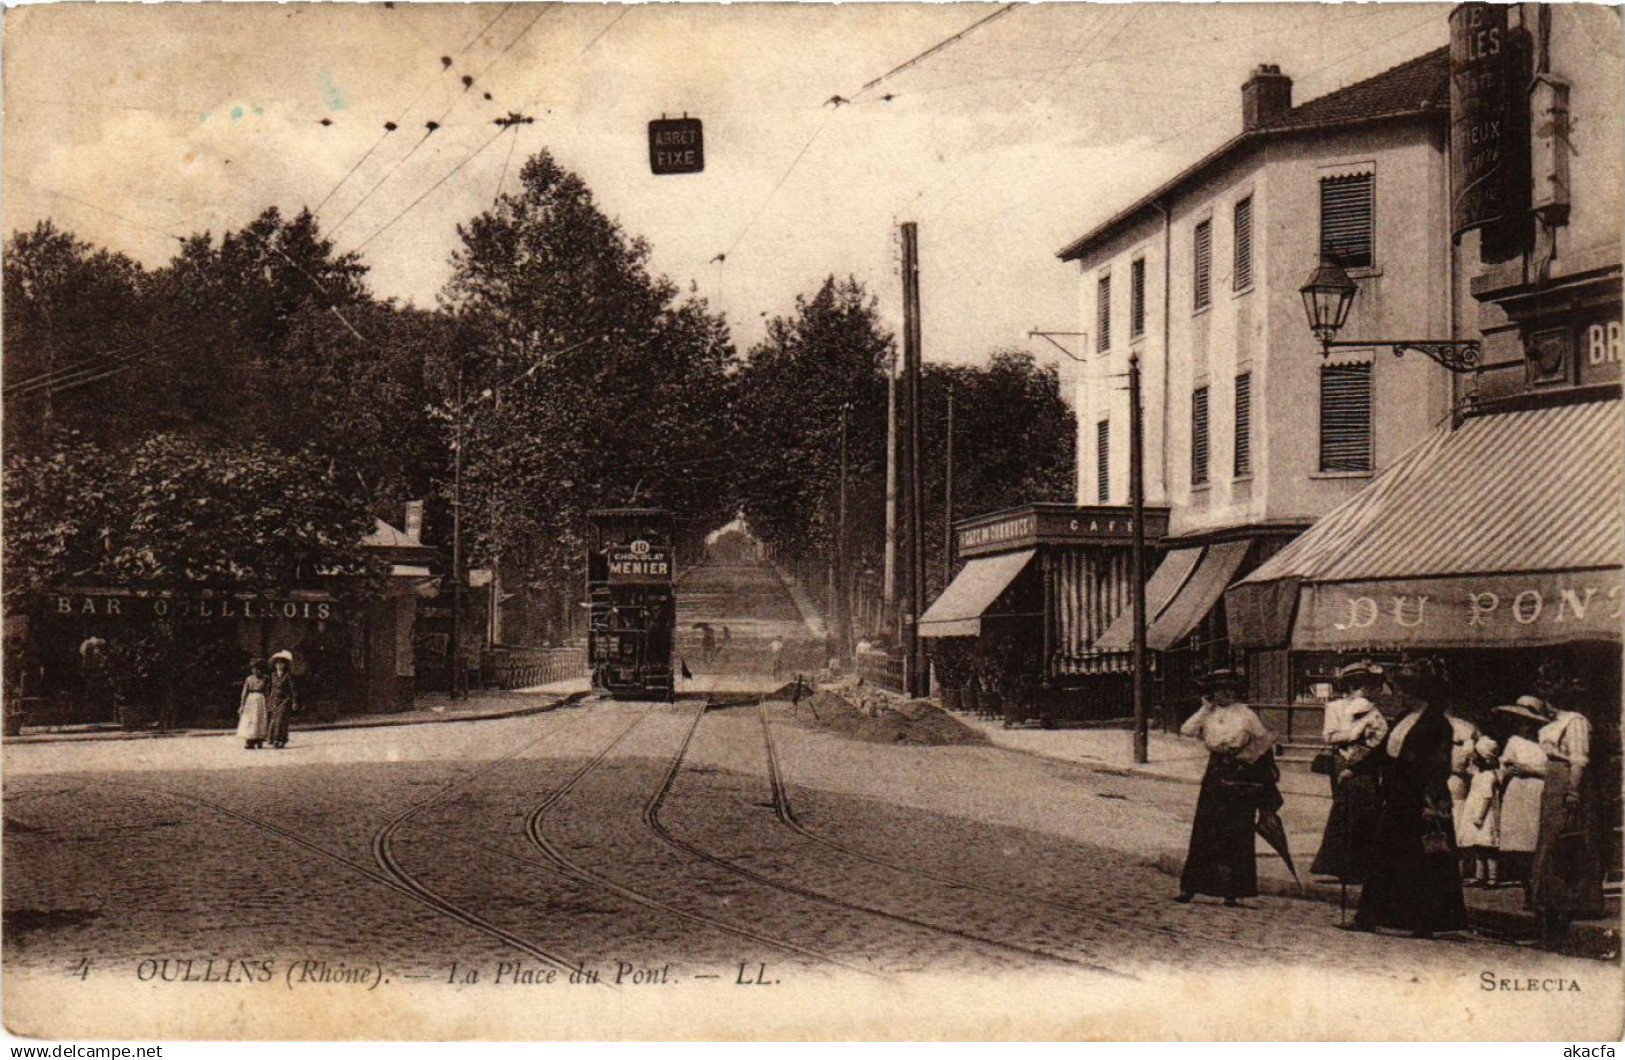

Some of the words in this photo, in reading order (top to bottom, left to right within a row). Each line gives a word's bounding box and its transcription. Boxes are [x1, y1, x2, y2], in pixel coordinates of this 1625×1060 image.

[658, 150, 695, 167] FIXE
[634, 542, 648, 551] 10
[614, 552, 664, 560] CHOCOLAT
[609, 562, 668, 574] MENIER
[57, 599, 121, 615] BAR
[1334, 596, 1429, 631] DU
